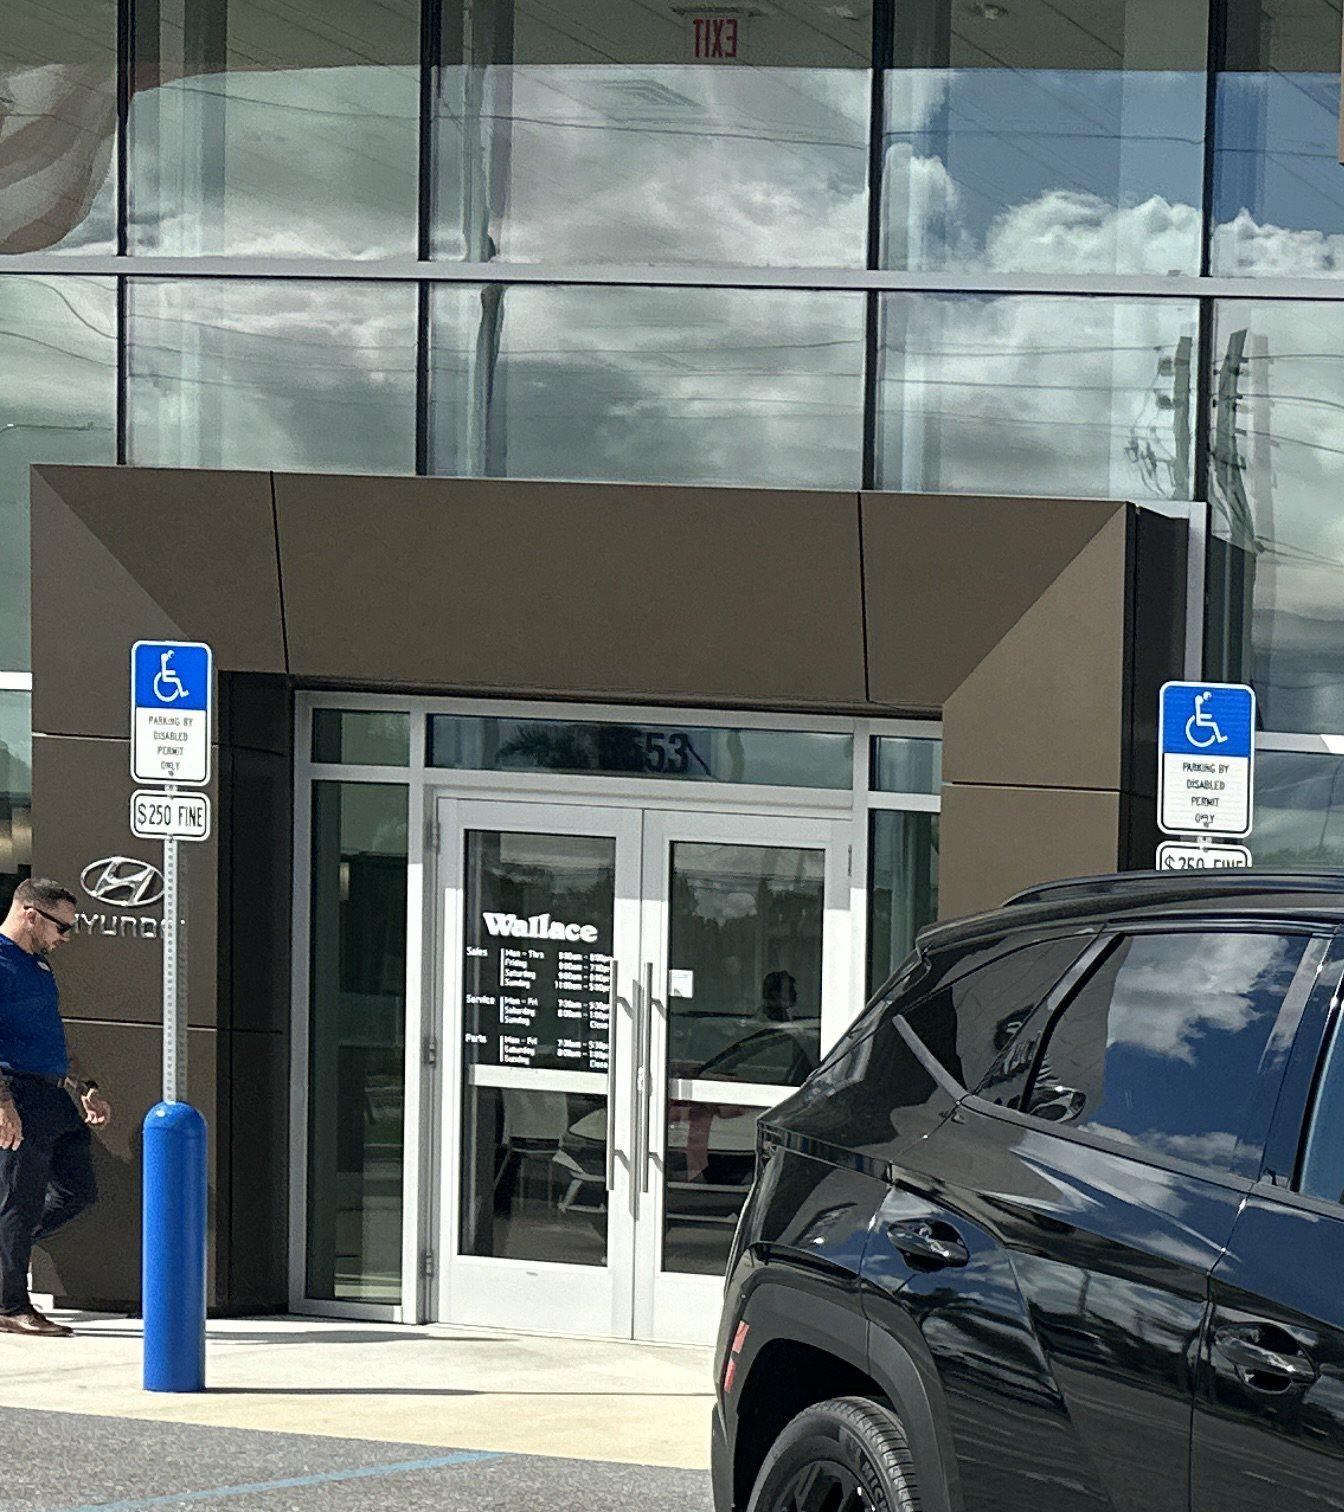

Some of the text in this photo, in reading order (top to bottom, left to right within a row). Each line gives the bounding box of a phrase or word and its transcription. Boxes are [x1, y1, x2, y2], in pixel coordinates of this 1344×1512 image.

[148, 716, 180, 726] PARKING
[154, 731, 188, 741] DISABLED
[157, 746, 184, 755] PERMIT
[1183, 762, 1229, 773] PARKING BY
[1186, 779, 1225, 790] DISABLED
[138, 803, 203, 827] $250 FINE
[482, 912, 598, 943] Wallace
[466, 946, 488, 956] Sales
[505, 958, 528, 969] Friday
[505, 968, 536, 980] Saturday
[504, 978, 530, 989] Sunday
[466, 994, 496, 1005] Service
[504, 1006, 536, 1018] Saturday
[504, 1016, 530, 1026] Sunday
[465, 1033, 488, 1044] Parts
[504, 1044, 536, 1056] Saturday
[504, 1054, 530, 1066] Sunday
